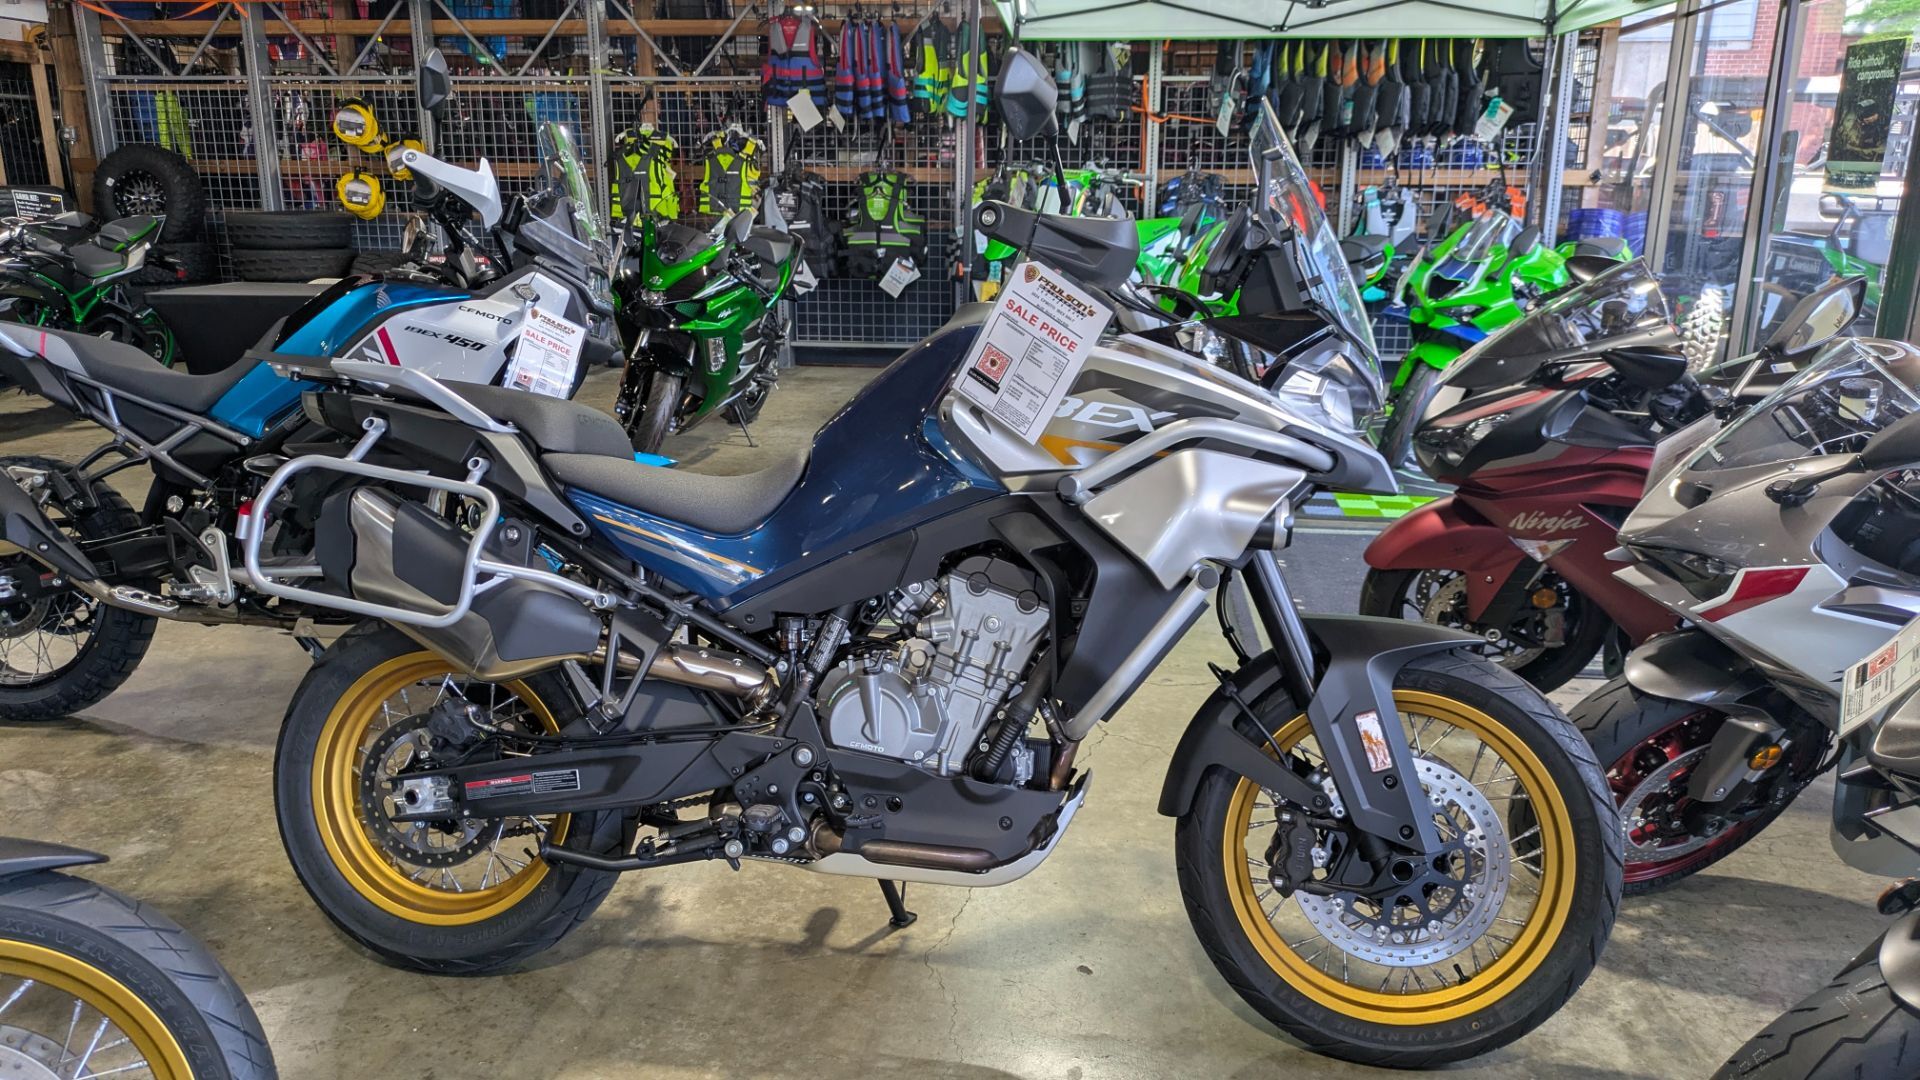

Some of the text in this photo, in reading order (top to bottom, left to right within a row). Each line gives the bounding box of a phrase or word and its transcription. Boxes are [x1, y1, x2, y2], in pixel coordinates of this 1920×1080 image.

[1847, 54, 1885, 69] Ride without
[1857, 69, 1896, 83] compromise.
[458, 305, 513, 325] CFMOTO
[1005, 298, 1039, 327] SALE
[1039, 321, 1078, 353] PRICE
[404, 325, 488, 352] IBEX 450
[525, 329, 546, 344] SALE
[547, 340, 572, 356] PRICE
[1054, 396, 1178, 432] BEX
[1508, 509, 1590, 537] Ninja
[850, 741, 885, 753] CFMOTO
